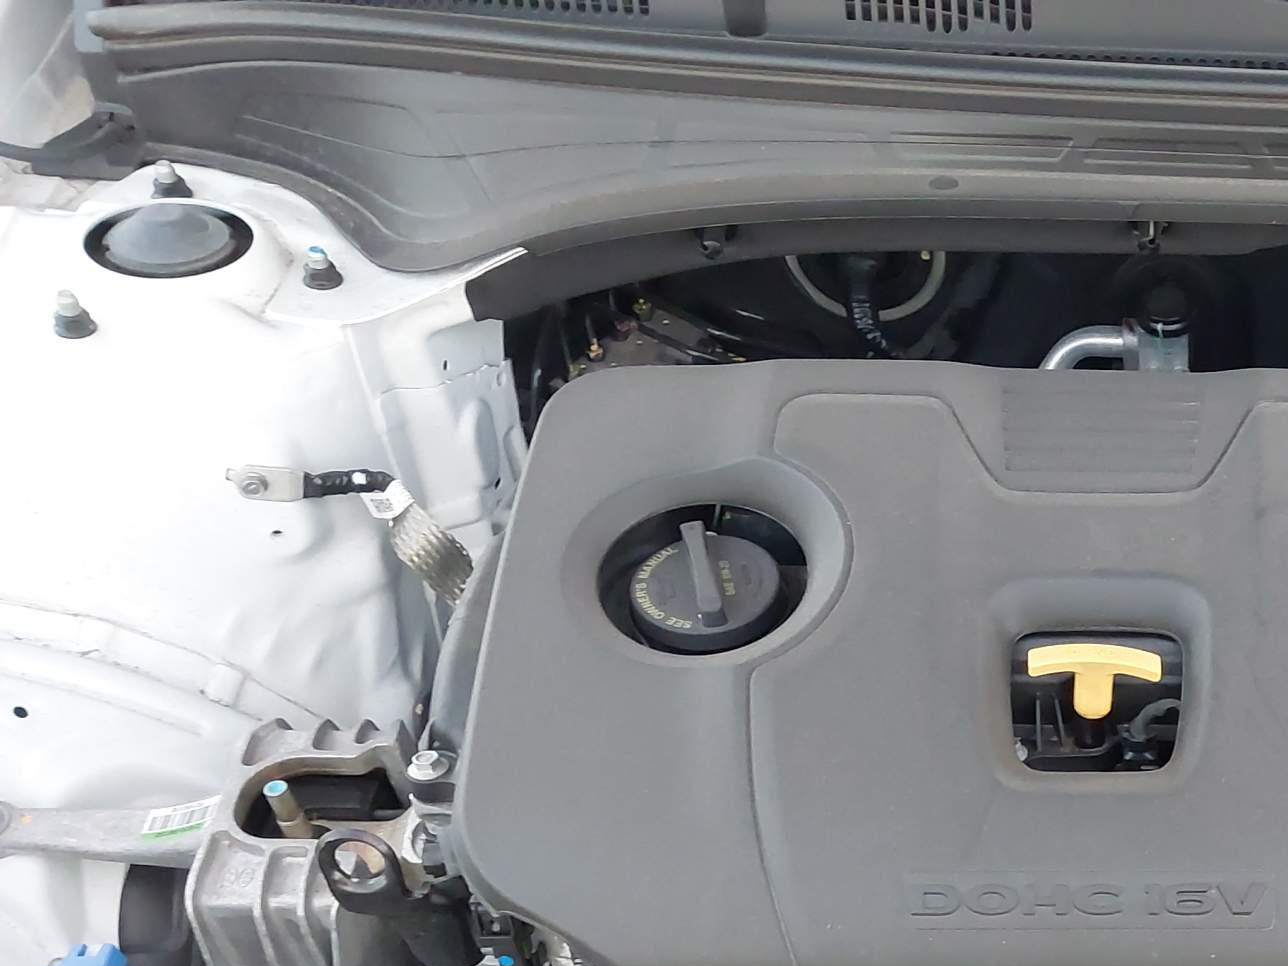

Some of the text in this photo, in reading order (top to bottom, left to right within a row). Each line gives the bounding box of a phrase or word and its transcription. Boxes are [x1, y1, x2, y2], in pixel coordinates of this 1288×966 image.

[637, 547, 680, 579] MANUAL
[664, 616, 693, 629] SEE
[911, 882, 1268, 918] DOHC 16V
